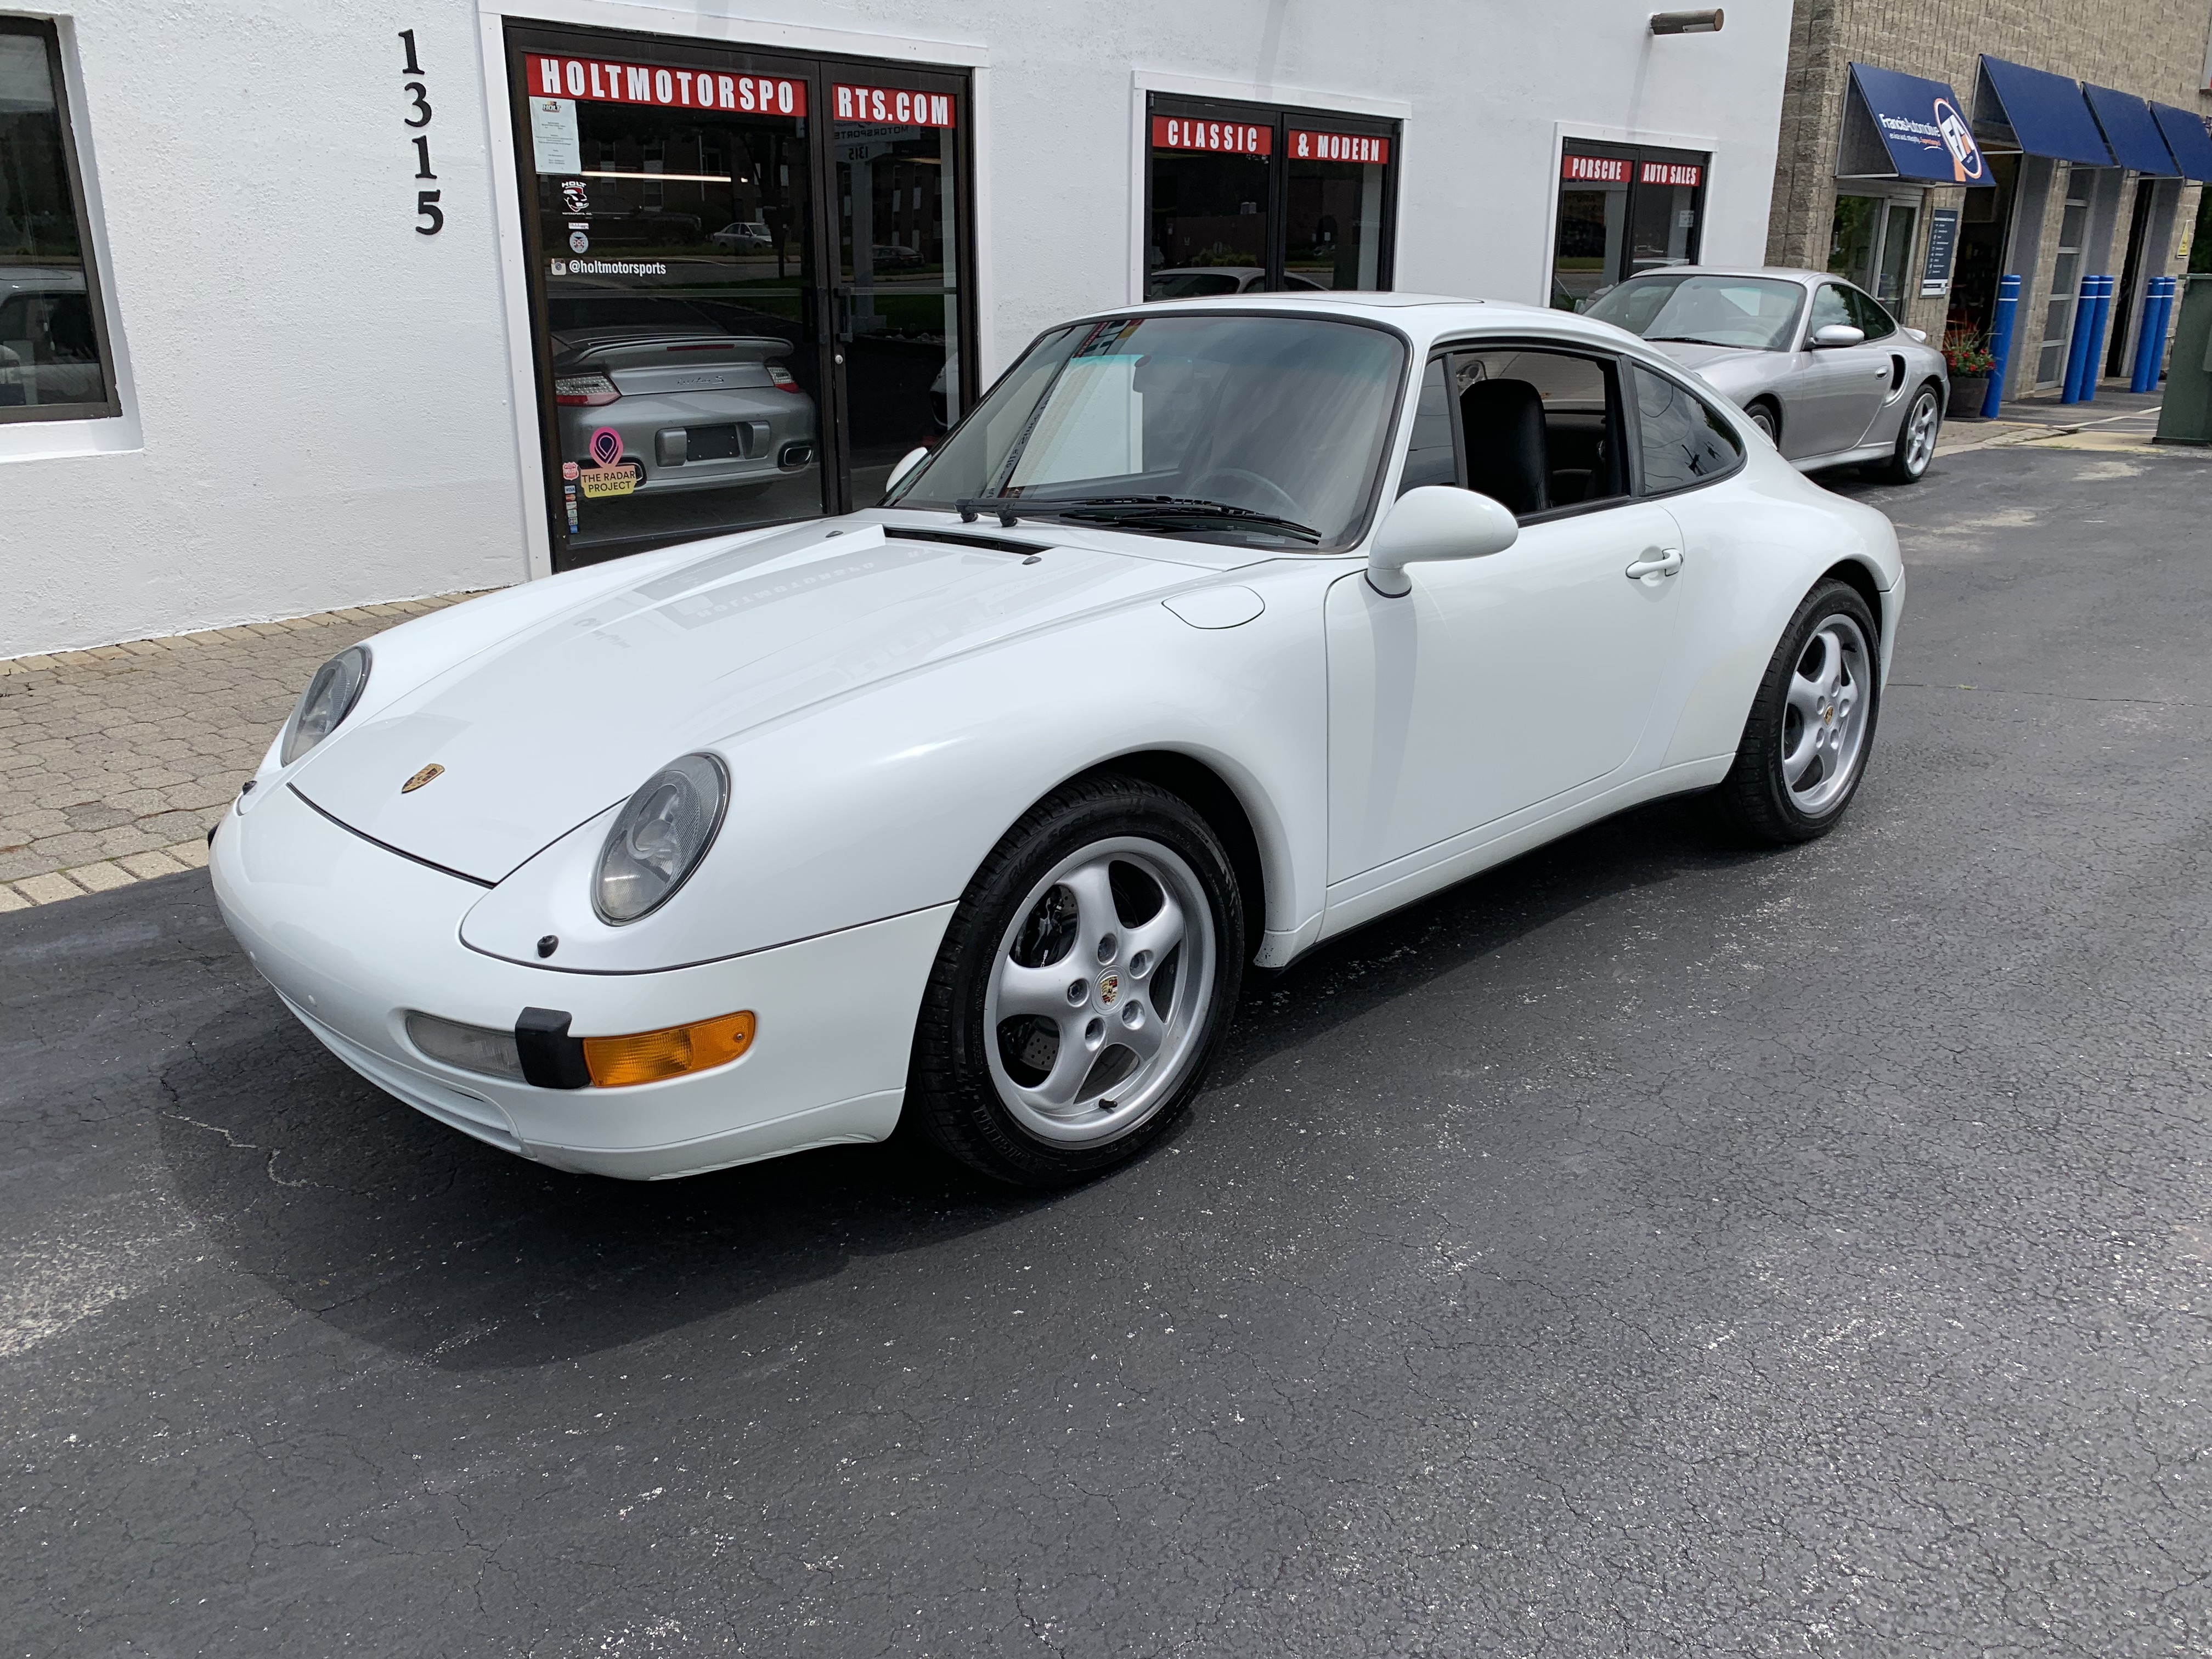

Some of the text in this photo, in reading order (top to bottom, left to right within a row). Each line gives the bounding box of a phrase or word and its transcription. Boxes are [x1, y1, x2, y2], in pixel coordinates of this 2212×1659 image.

[540, 58, 794, 114] HOLTMOTORSPO
[838, 86, 949, 126] RTS.COM
[398, 29, 444, 236] 1315
[1167, 119, 1257, 153] CLASSIC
[1297, 132, 1380, 162] & MODERN
[1572, 157, 1622, 180] PORSCHE
[1643, 163, 1697, 185] AUTO SALES
[569, 259, 667, 276] @holtmotorsports
[582, 471, 635, 483] THE RADAR
[589, 481, 631, 493] PROJECT
